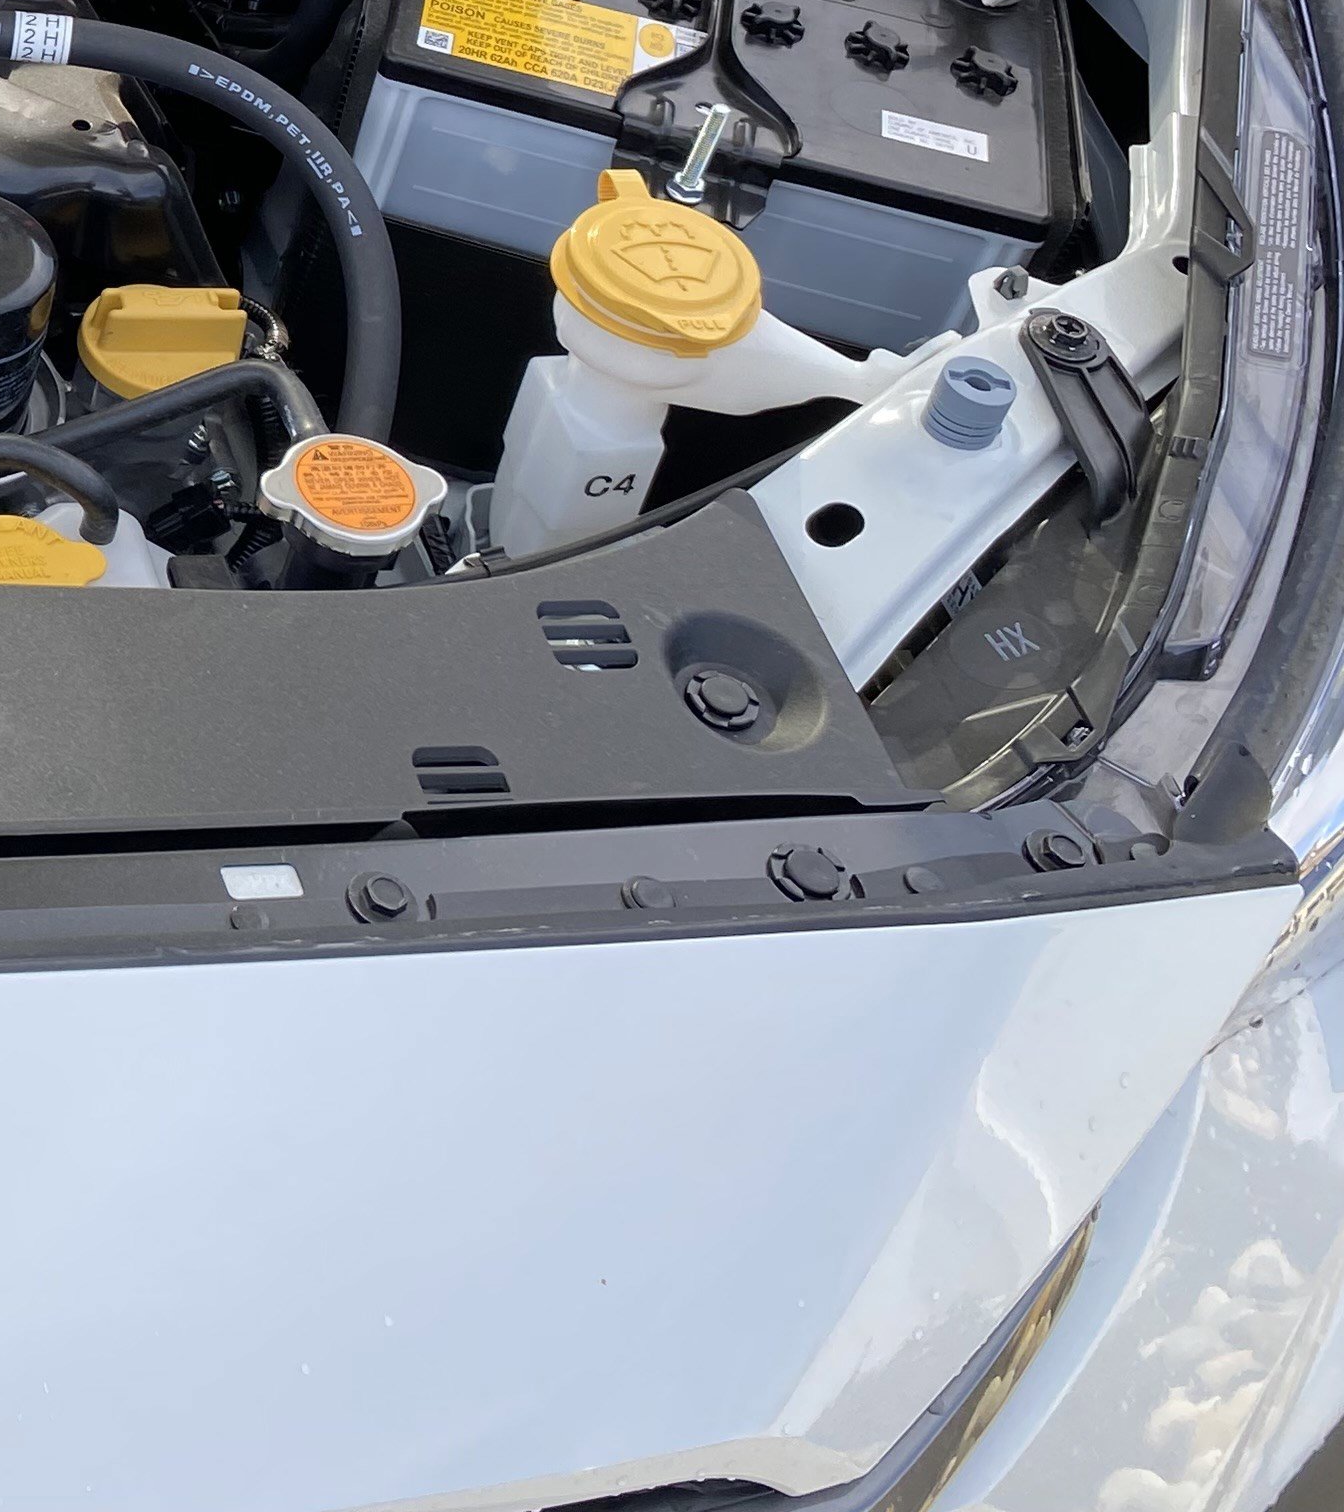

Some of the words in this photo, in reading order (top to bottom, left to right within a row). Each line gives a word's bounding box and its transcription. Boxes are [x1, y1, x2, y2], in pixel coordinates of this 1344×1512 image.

[430, 0, 486, 20] POISON
[494, 16, 532, 31] CAUSES
[458, 45, 488, 60] 20HR
[490, 53, 518, 68] 62Ah
[523, 61, 548, 75] CCA
[466, 37, 492, 49] KEEP
[493, 44, 512, 55] OUT
[515, 50, 527, 58] OF
[529, 53, 563, 67] REACH
[467, 30, 493, 41] KEEP
[495, 37, 519, 48] VENT
[578, 58, 598, 69] AND
[676, 319, 726, 331] PULL
[583, 473, 637, 498] C4
[984, 621, 1041, 662] HX
